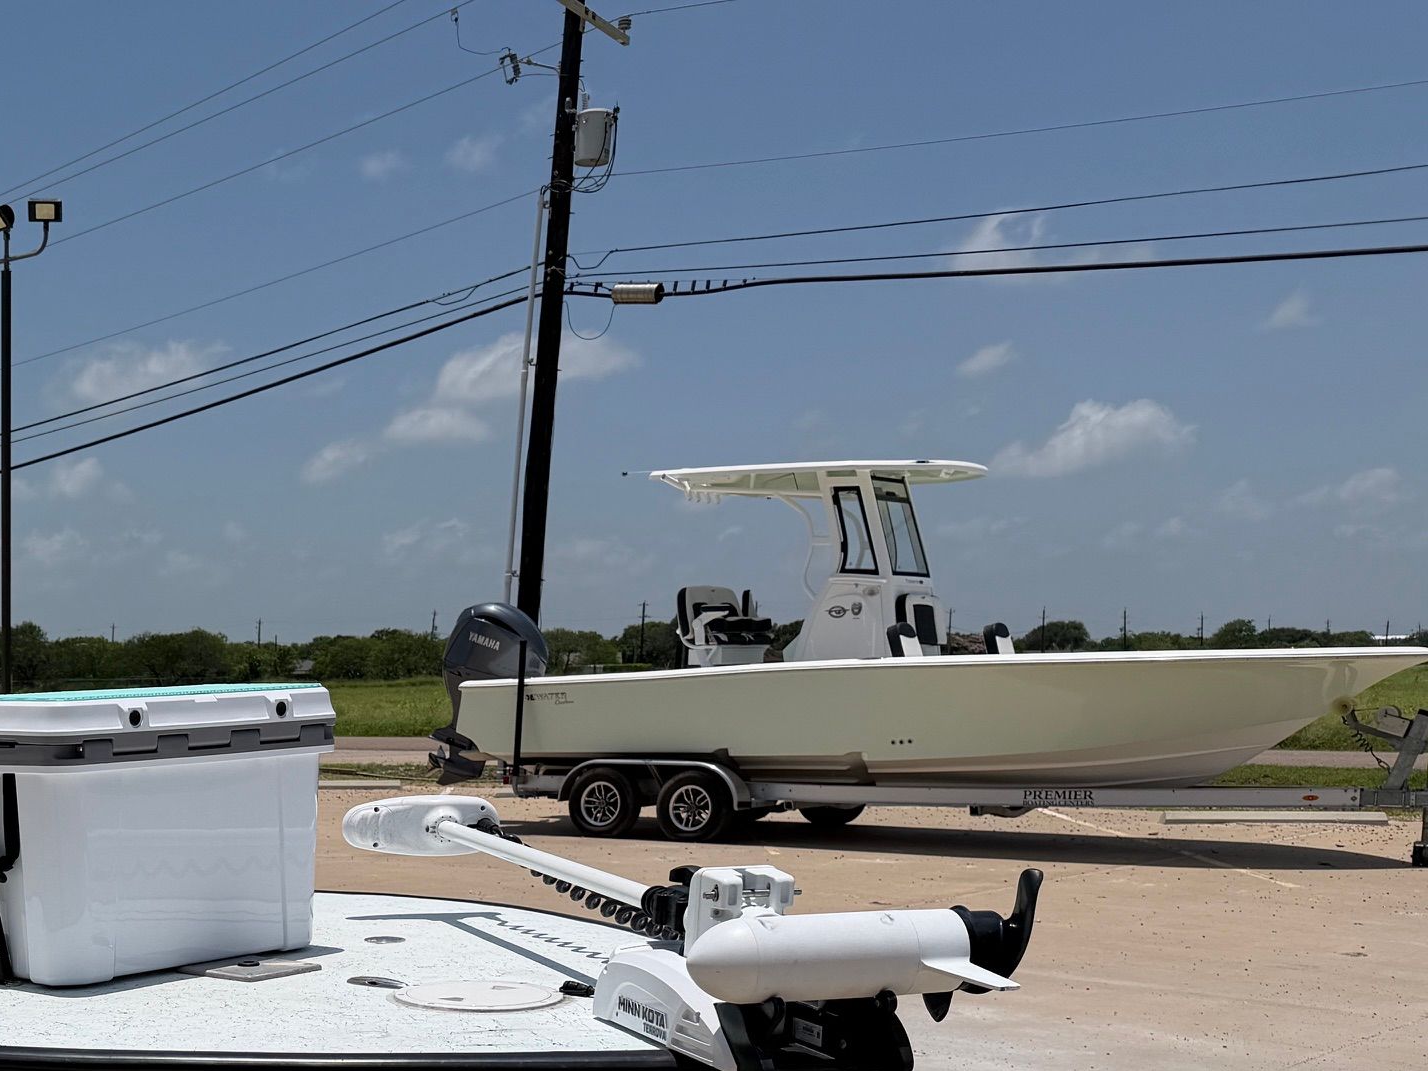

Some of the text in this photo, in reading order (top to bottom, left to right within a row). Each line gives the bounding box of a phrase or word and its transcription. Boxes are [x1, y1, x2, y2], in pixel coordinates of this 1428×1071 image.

[468, 631, 501, 651] YAMAHA
[1023, 790, 1094, 800] PREMIER
[618, 995, 667, 1030] MINN KOTA
